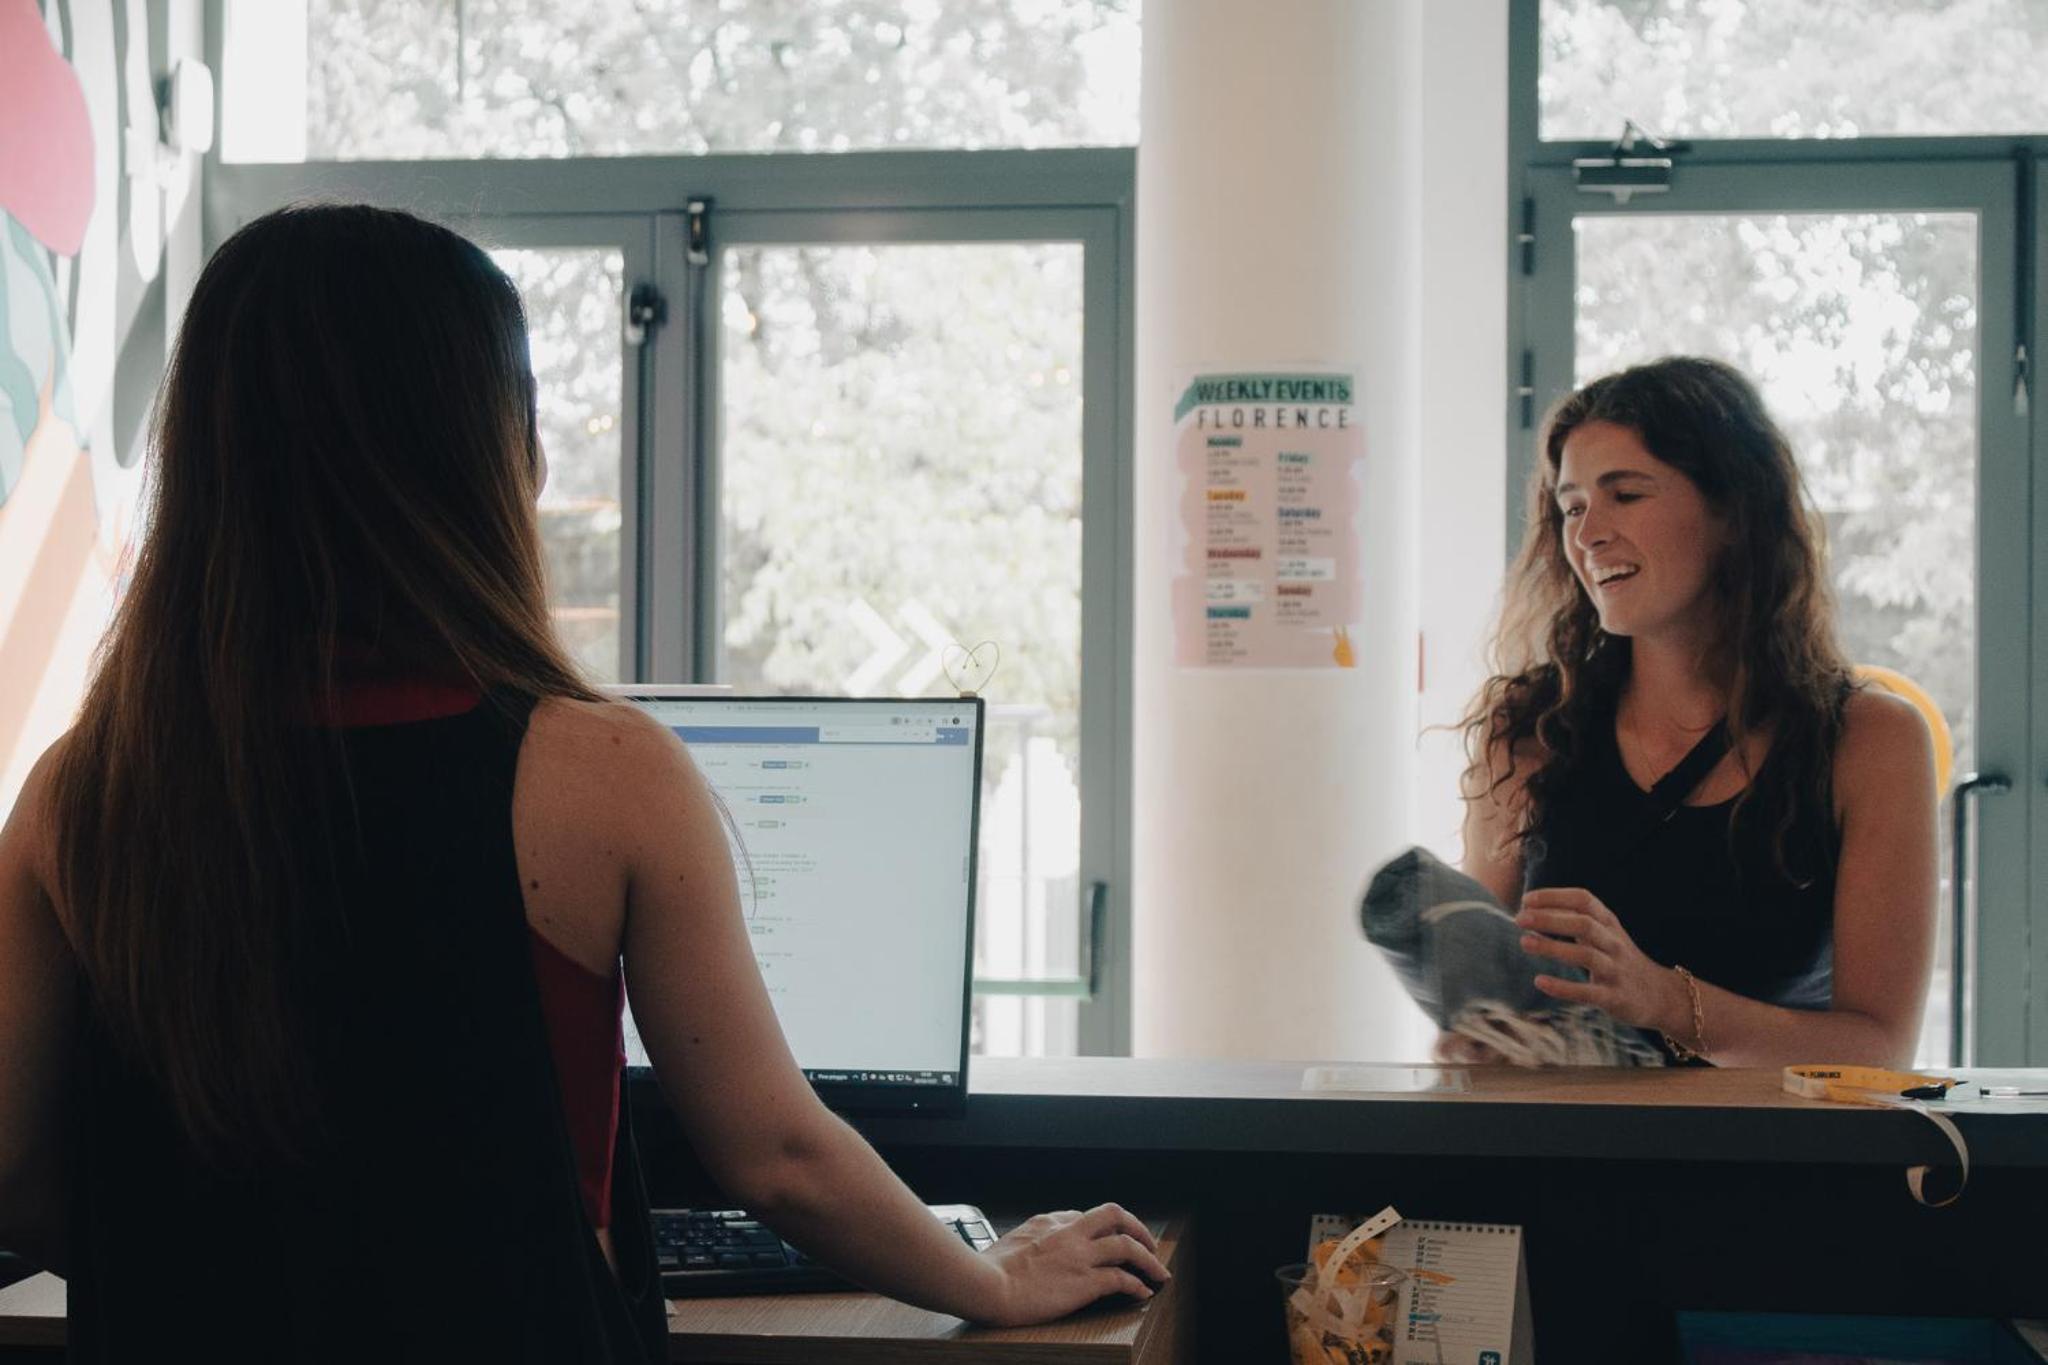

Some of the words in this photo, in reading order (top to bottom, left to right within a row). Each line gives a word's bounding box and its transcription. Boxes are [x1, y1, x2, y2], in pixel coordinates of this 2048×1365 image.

[1197, 381, 1271, 402] WEEKLY
[1198, 408, 1349, 430] FLORENCE
[1278, 507, 1322, 519] Saturday
